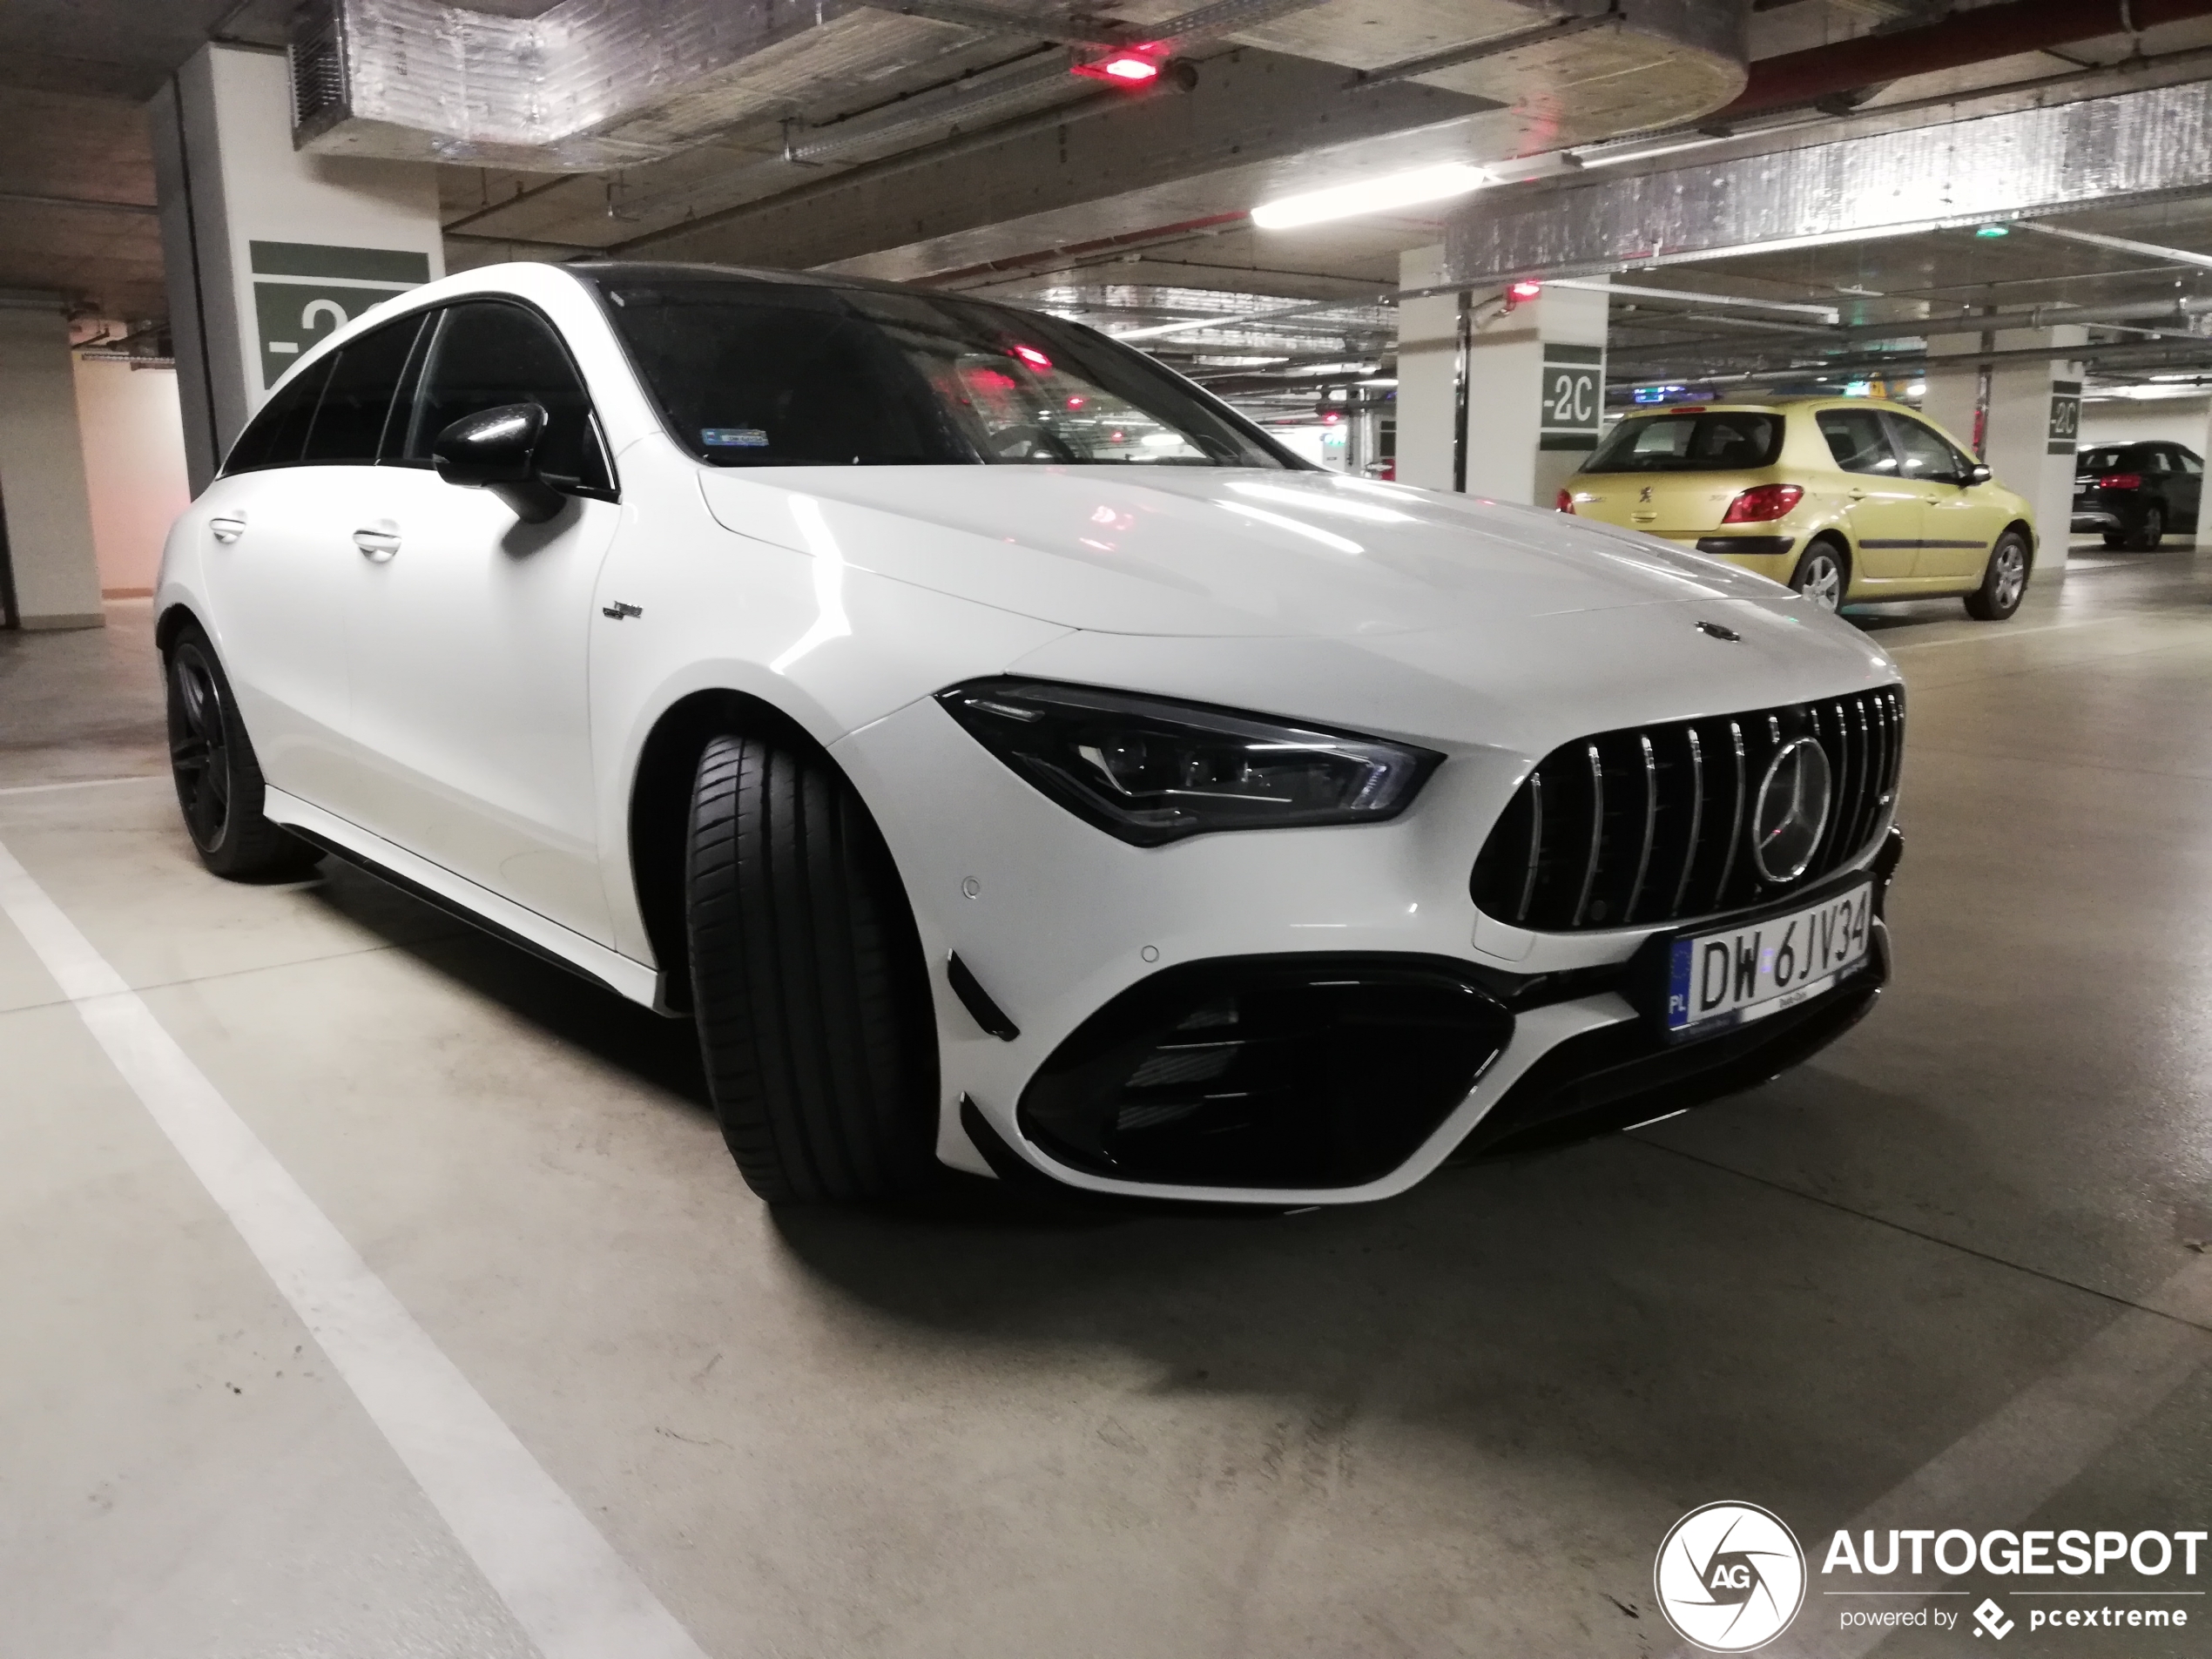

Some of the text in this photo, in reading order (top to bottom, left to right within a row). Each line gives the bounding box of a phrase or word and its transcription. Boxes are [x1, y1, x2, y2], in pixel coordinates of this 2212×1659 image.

[269, 299, 384, 354] -2
[1543, 374, 1593, 421] -2C
[2050, 401, 2076, 434] -2C
[1701, 891, 1867, 1012] DW 6JV34
[1669, 994, 1687, 1015] PL
